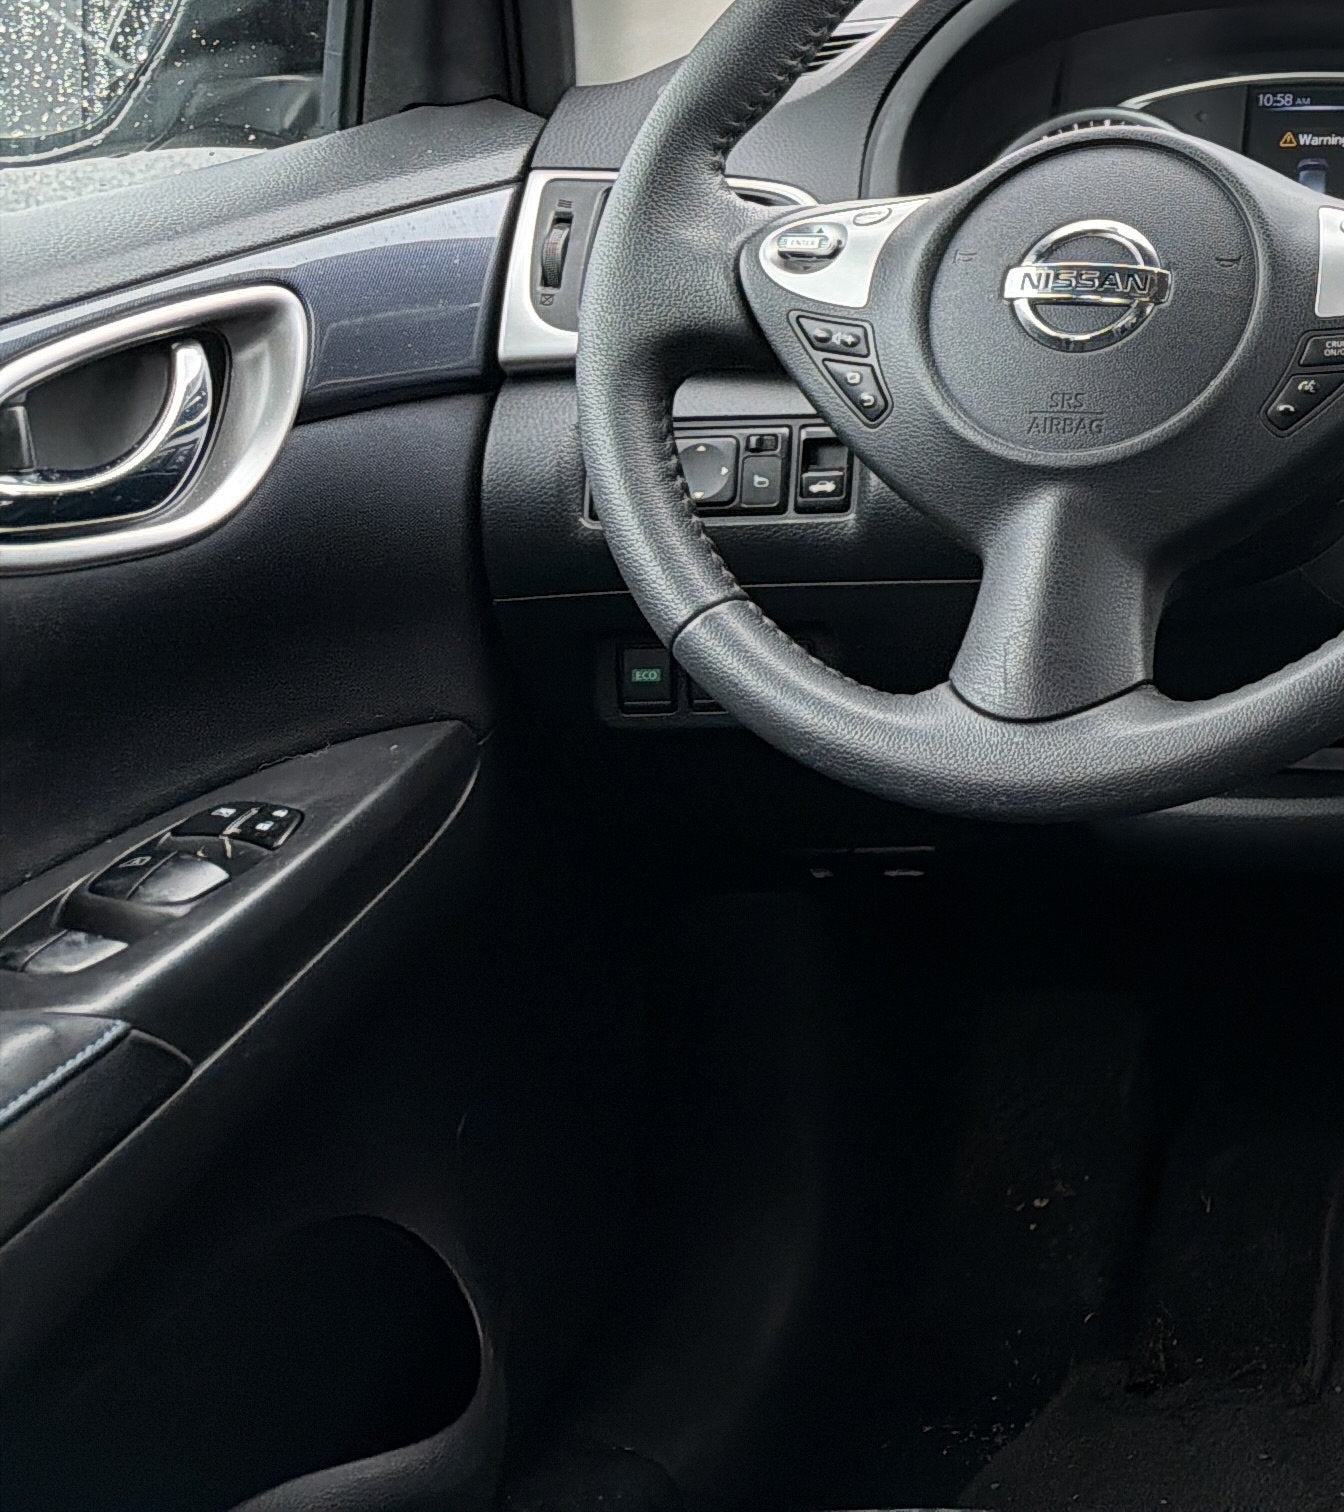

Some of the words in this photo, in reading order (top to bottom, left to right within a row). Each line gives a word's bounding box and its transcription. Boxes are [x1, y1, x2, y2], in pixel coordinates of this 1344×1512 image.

[1258, 94, 1293, 106] 10:58
[1021, 270, 1151, 294] NISSAN
[1050, 392, 1086, 408] SRS
[1026, 416, 1104, 435] AIRBAG
[635, 670, 659, 682] ECO
